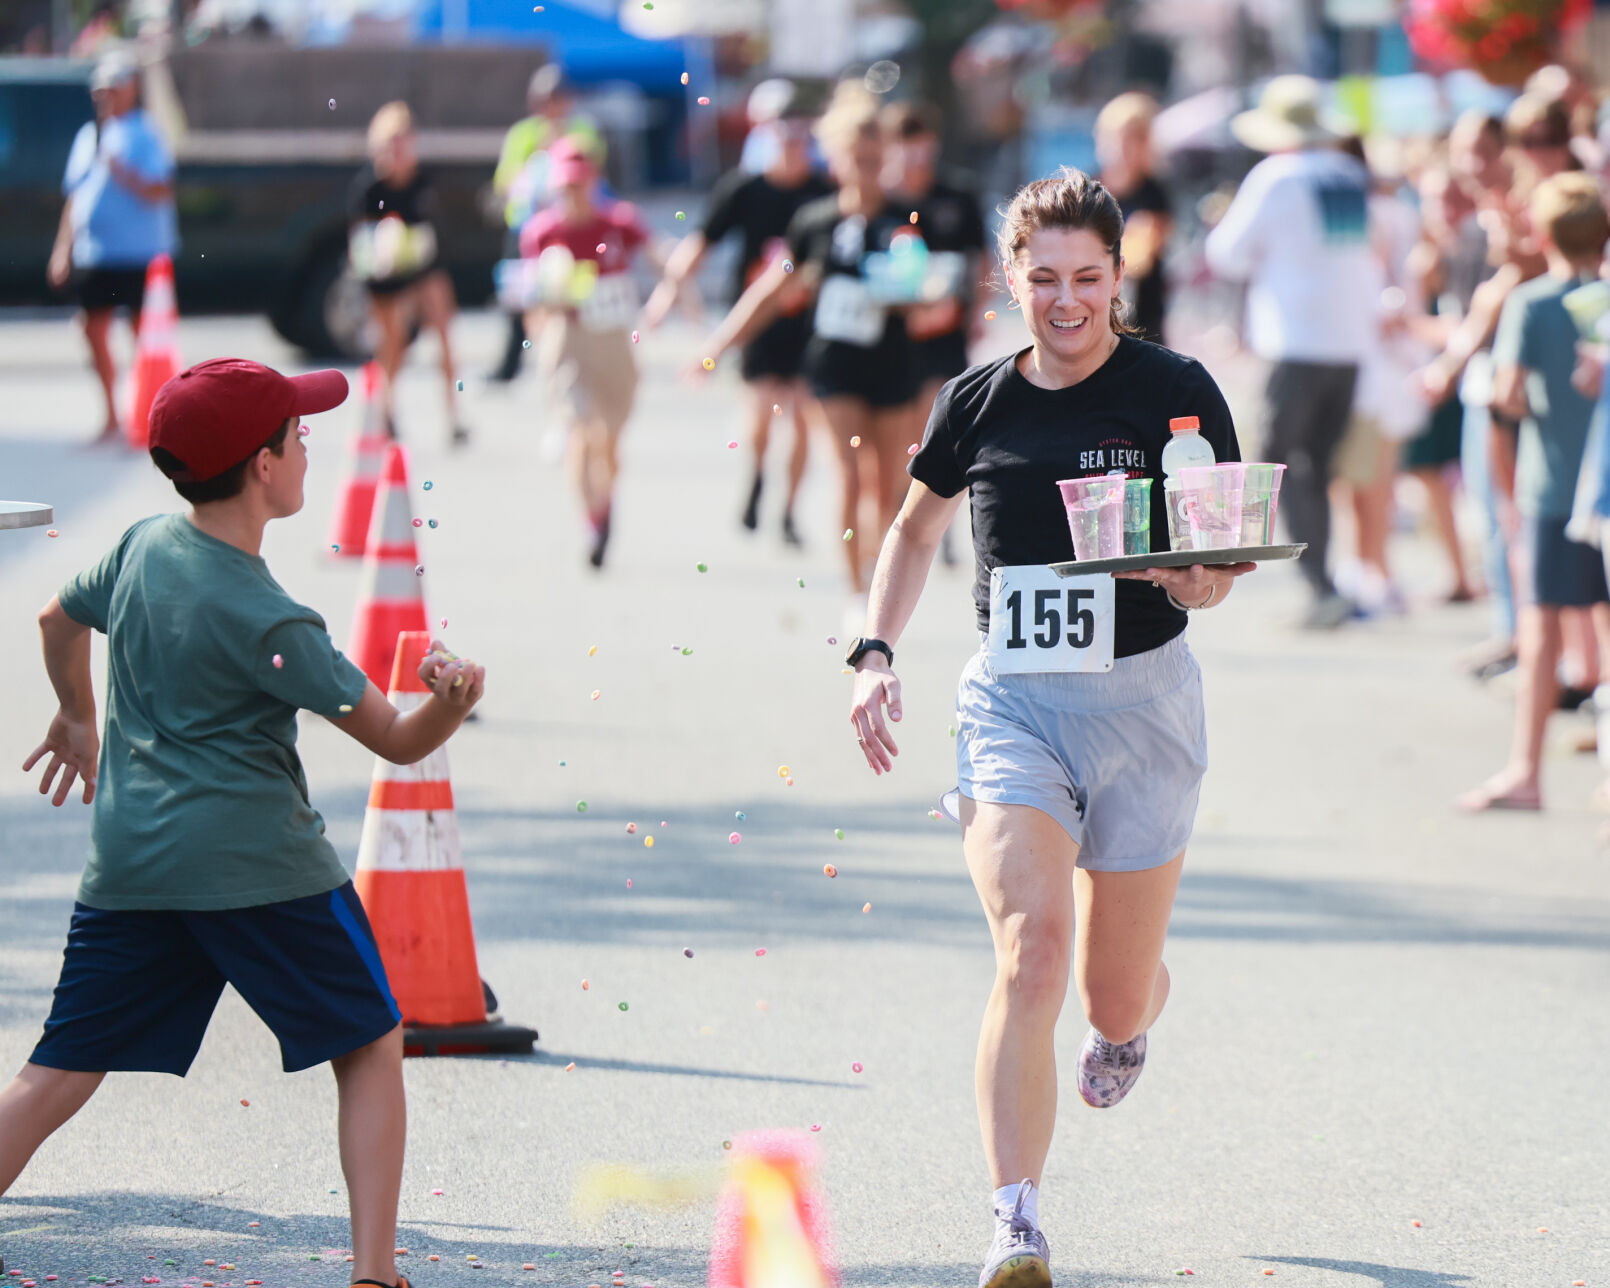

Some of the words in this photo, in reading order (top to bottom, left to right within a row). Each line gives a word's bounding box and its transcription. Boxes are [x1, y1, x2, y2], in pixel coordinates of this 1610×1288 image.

[1079, 449, 1105, 469] SEA
[1111, 449, 1147, 468] LEVEL
[1006, 589, 1095, 649] 155
